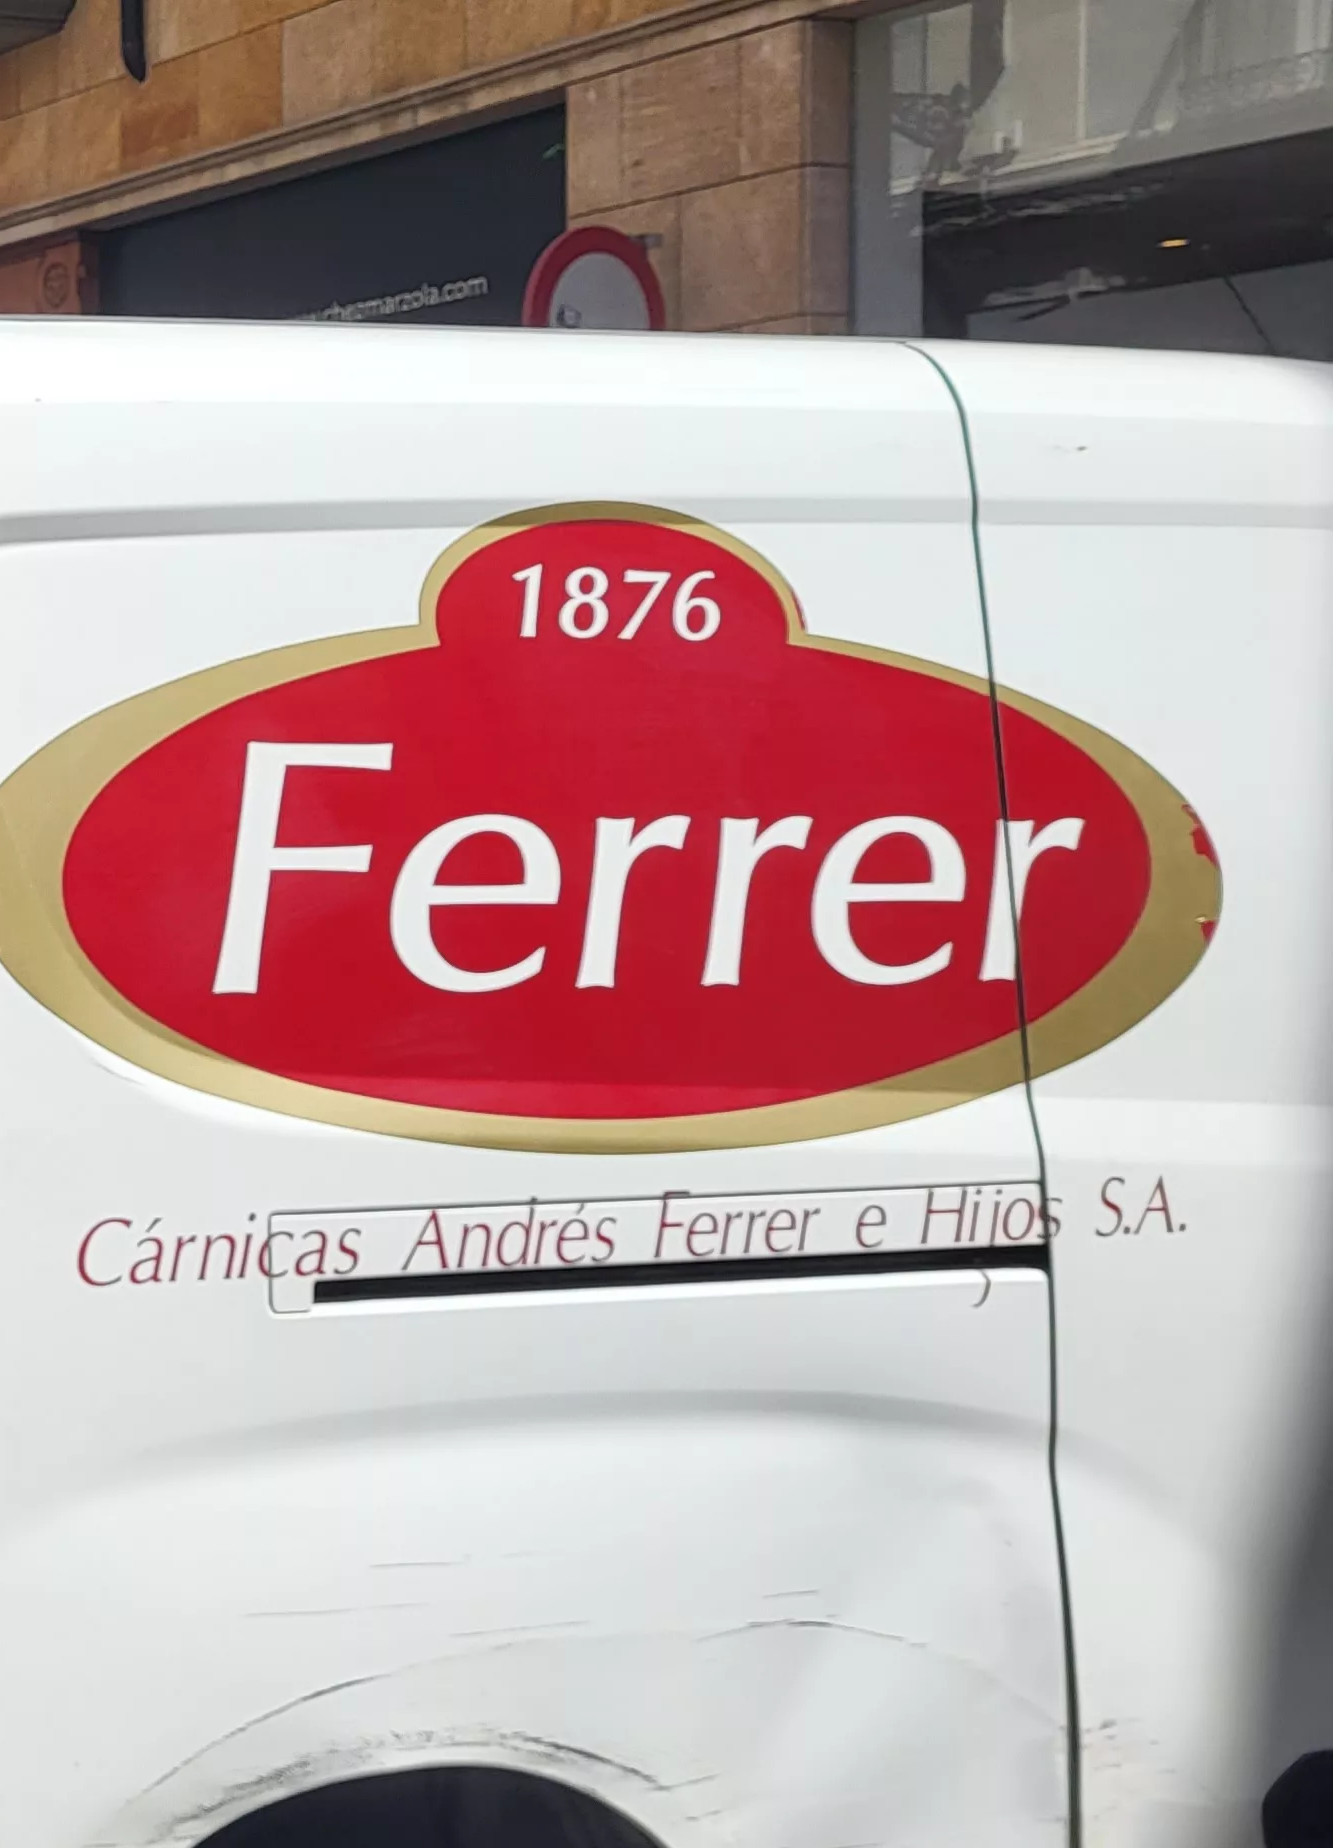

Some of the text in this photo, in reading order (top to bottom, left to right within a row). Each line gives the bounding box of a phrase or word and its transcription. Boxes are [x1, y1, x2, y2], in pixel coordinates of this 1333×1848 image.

[512, 563, 723, 643] 1876
[212, 740, 1085, 997] Ferrer
[77, 1175, 1188, 1308] Cárnicas Andrés Ferrer e Hijos S.A.
